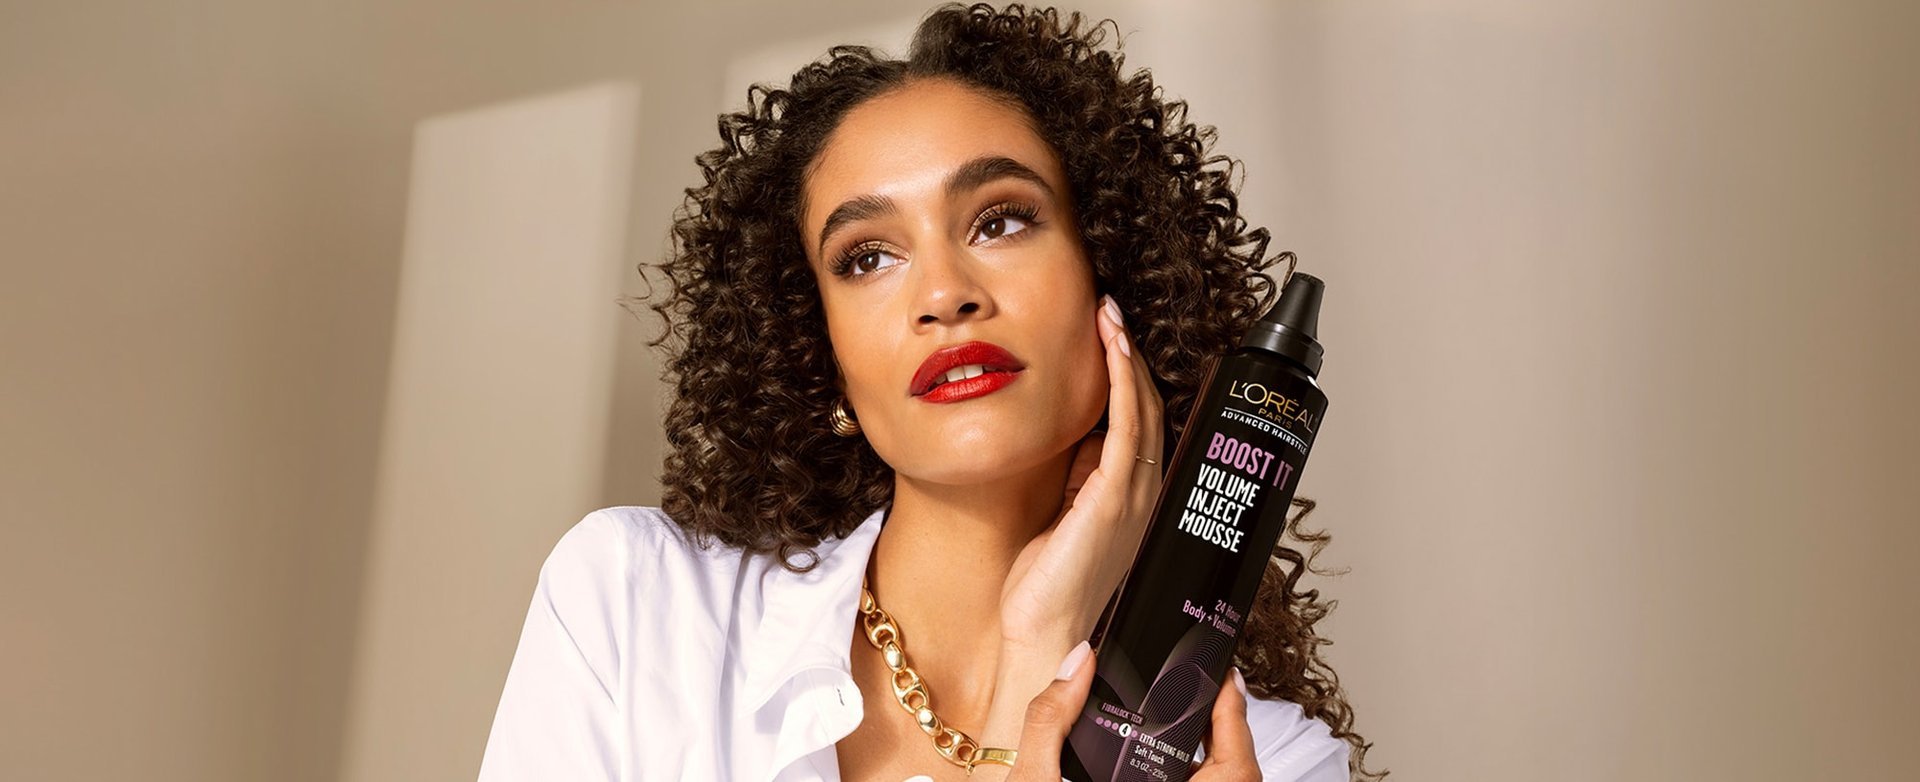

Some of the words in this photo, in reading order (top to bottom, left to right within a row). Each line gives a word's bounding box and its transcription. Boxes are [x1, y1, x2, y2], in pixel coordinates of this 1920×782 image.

[1221, 410, 1270, 432] ADVANCED
[1271, 427, 1307, 455] HAIRSTYLE
[1258, 408, 1292, 429] PARIS
[1206, 432, 1275, 480] BOOST
[1273, 460, 1294, 491] IT
[1197, 463, 1261, 507] VOLUME
[1186, 486, 1246, 527] INJECT
[1178, 509, 1244, 553] MOUSSE
[1182, 599, 1206, 623] Body
[1212, 614, 1236, 637] Volume
[1215, 600, 1227, 614] 24
[1134, 744, 1148, 757] Soft
[1147, 750, 1165, 765] Touch
[1139, 733, 1156, 748] EXTRA
[1156, 740, 1177, 757] STRONG
[1175, 749, 1190, 763] HOLD
